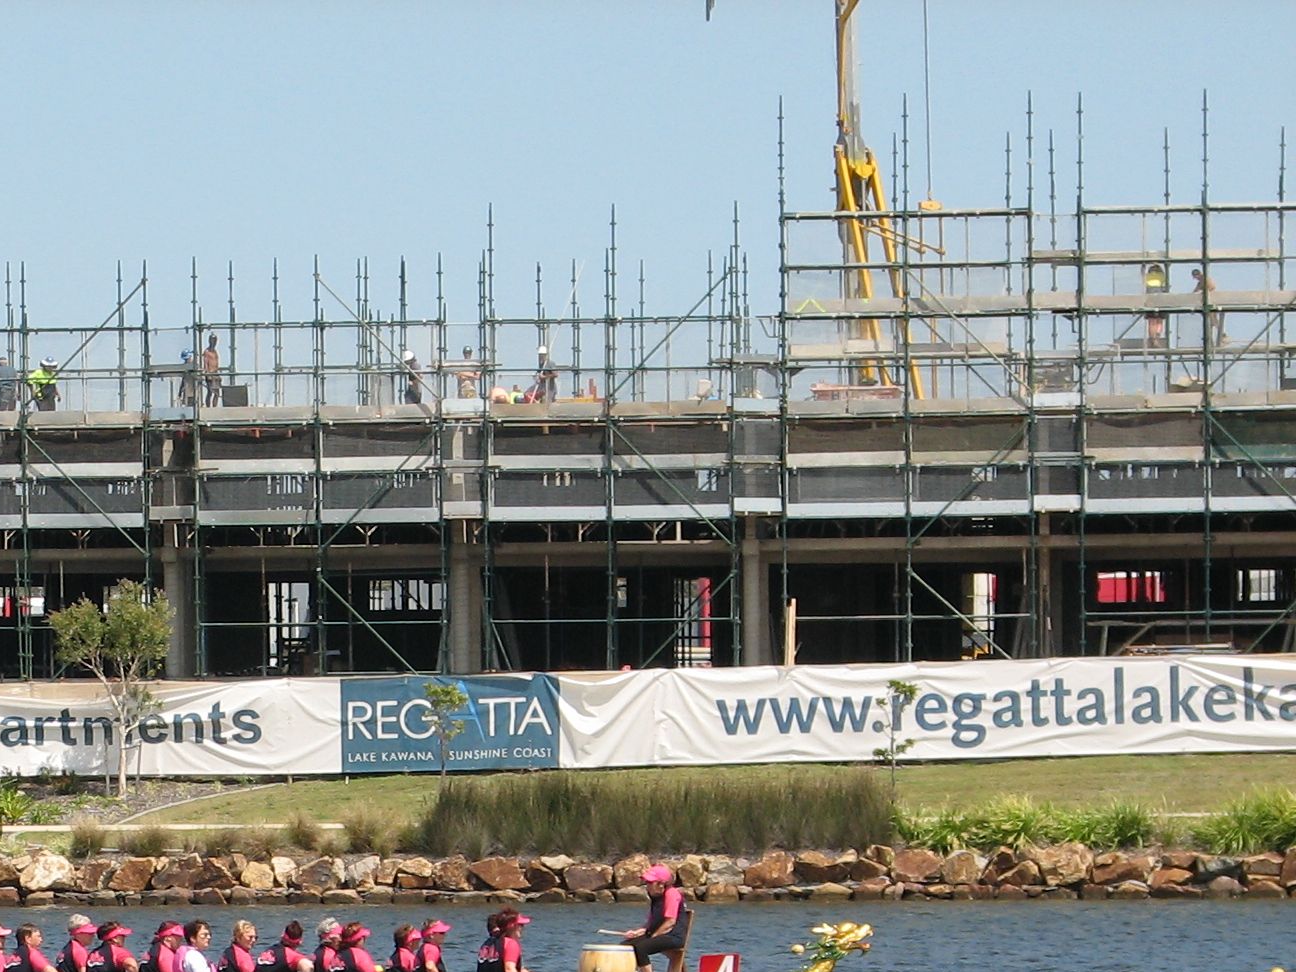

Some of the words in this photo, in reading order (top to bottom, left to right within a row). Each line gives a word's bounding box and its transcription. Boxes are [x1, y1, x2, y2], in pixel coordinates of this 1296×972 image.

[348, 752, 377, 763] LAKE
[381, 751, 435, 762] KAWANA
[448, 748, 508, 761] SUNSHINE
[513, 747, 552, 759] COAST
